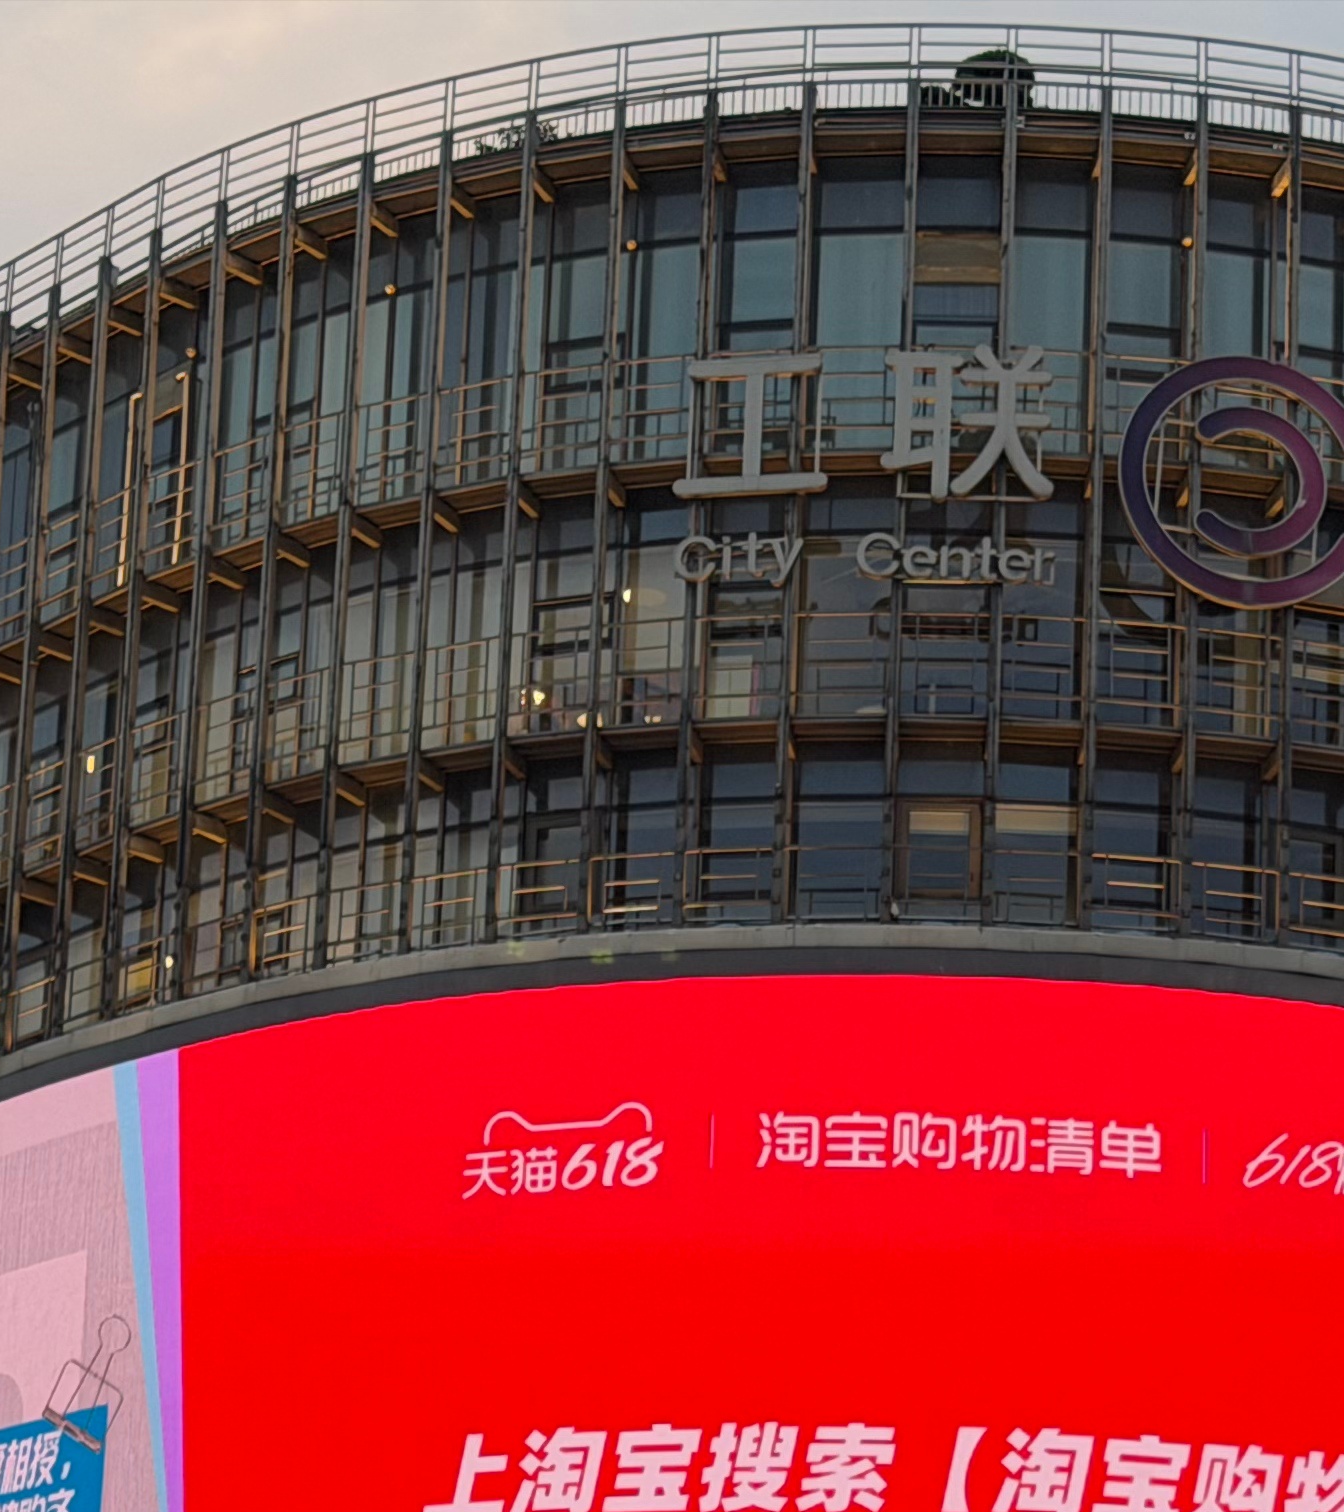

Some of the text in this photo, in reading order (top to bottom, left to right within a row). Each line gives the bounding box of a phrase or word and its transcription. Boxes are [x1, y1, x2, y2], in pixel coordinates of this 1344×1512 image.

[672, 344, 1055, 503] 工联
[672, 531, 1055, 588] City Center
[462, 1134, 665, 1200] 天猫618
[755, 1110, 1163, 1180] 淘宝购物清单
